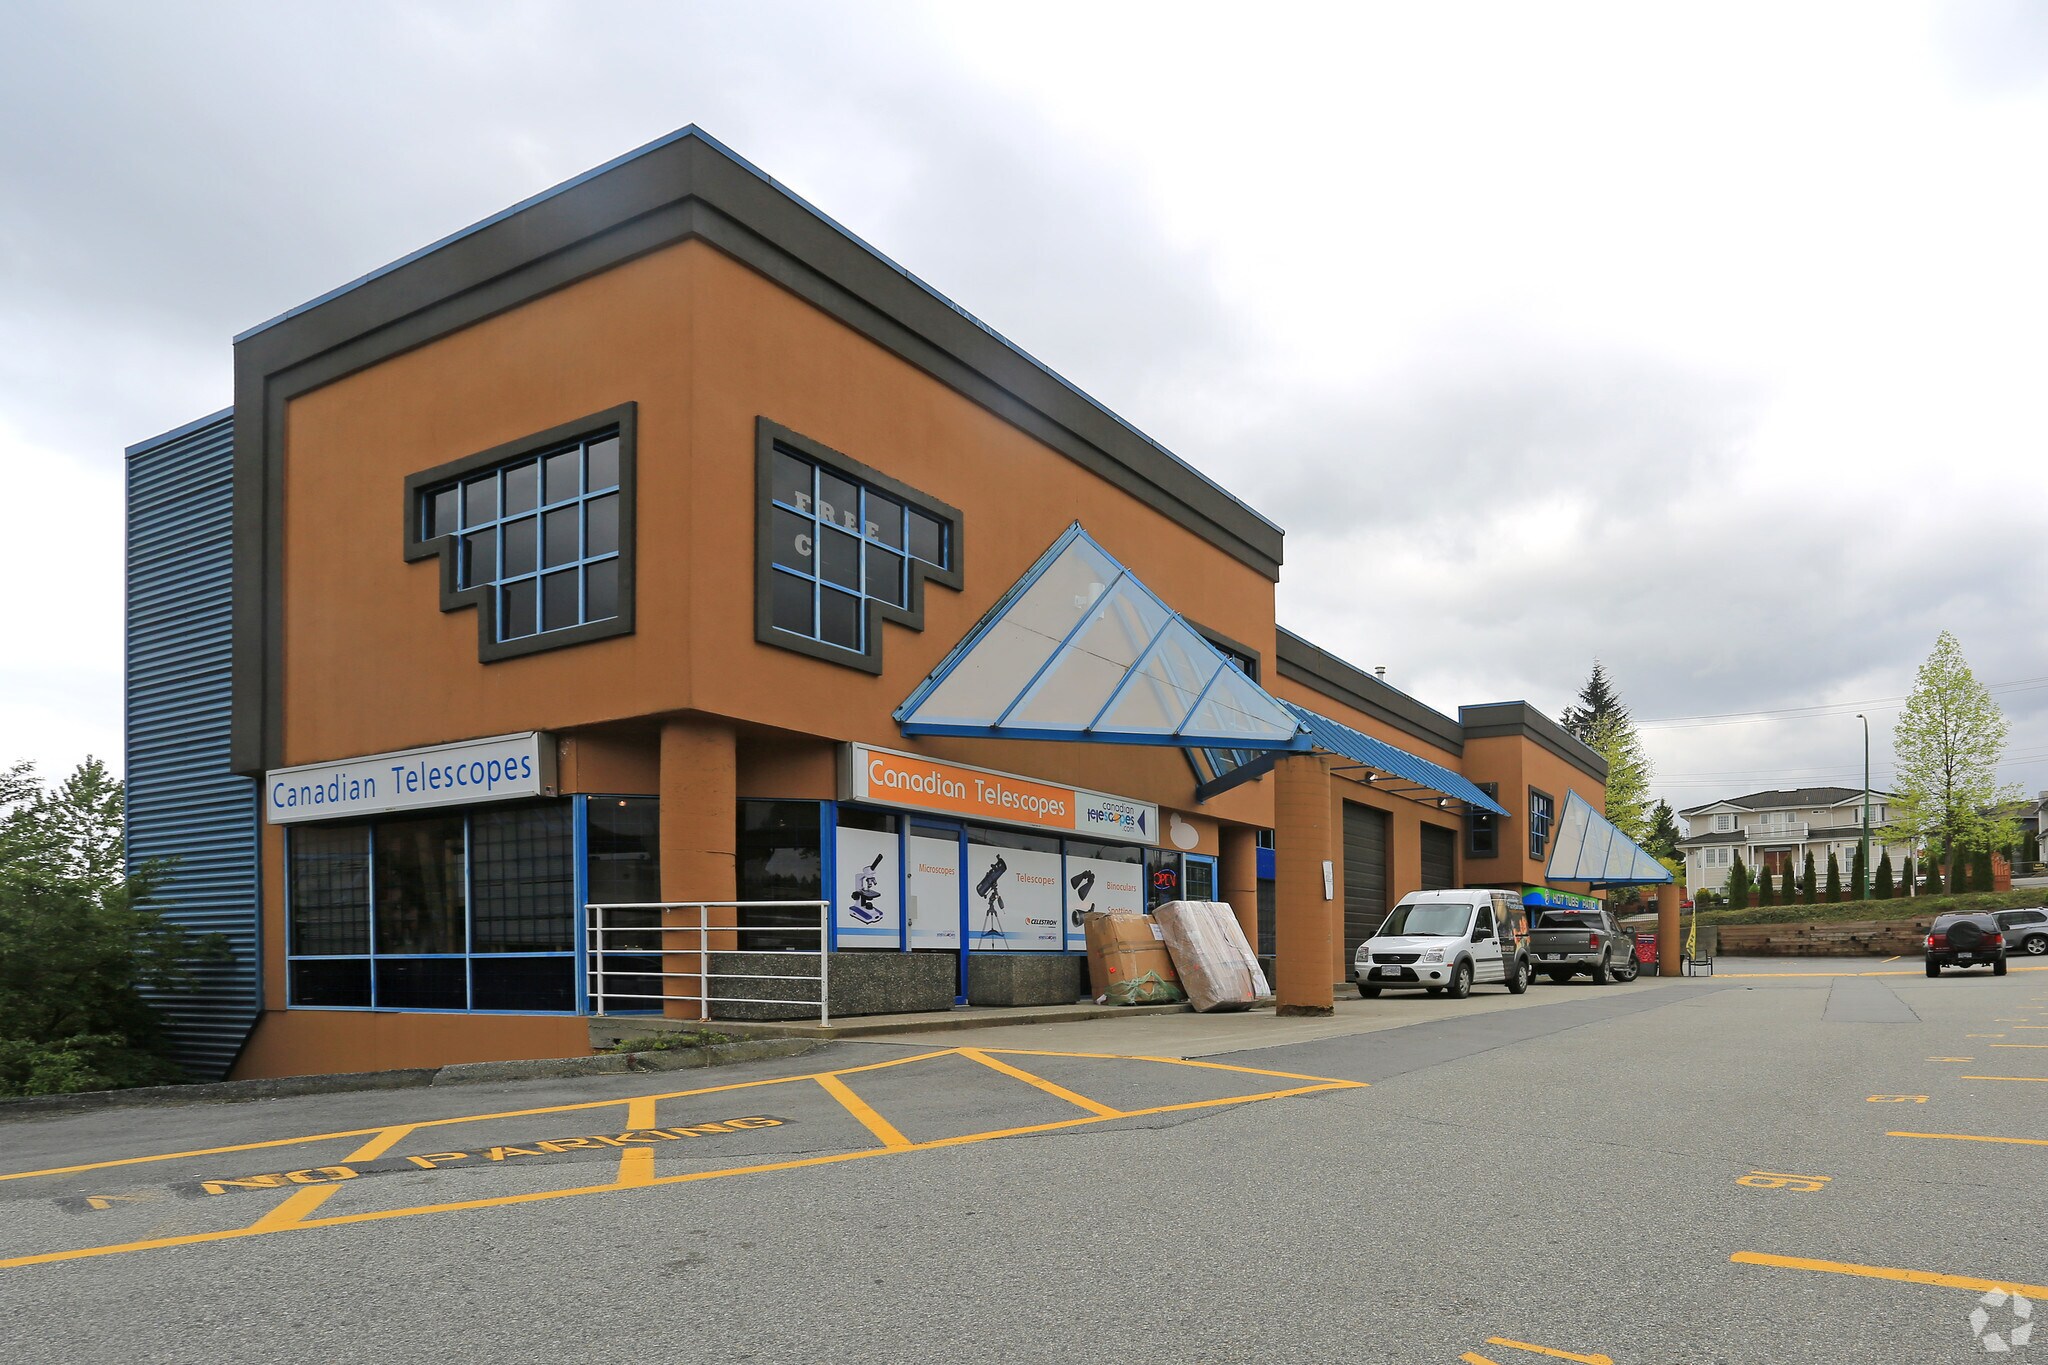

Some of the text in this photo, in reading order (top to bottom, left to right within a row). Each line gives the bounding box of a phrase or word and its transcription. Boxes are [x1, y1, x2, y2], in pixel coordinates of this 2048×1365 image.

[795, 490, 879, 541] FREE
[272, 755, 531, 808] Canadian Telescopes
[869, 759, 1066, 819] Canadian Telescopes
[1102, 802, 1135, 815] canadian
[919, 863, 955, 876] Microscopes
[1016, 872, 1055, 886] Telescopes
[1153, 872, 1177, 887] OPEN
[1106, 881, 1137, 892] Binoculars
[1030, 918, 1058, 926] CELESTRON
[202, 1116, 784, 1195] NO PARKING
